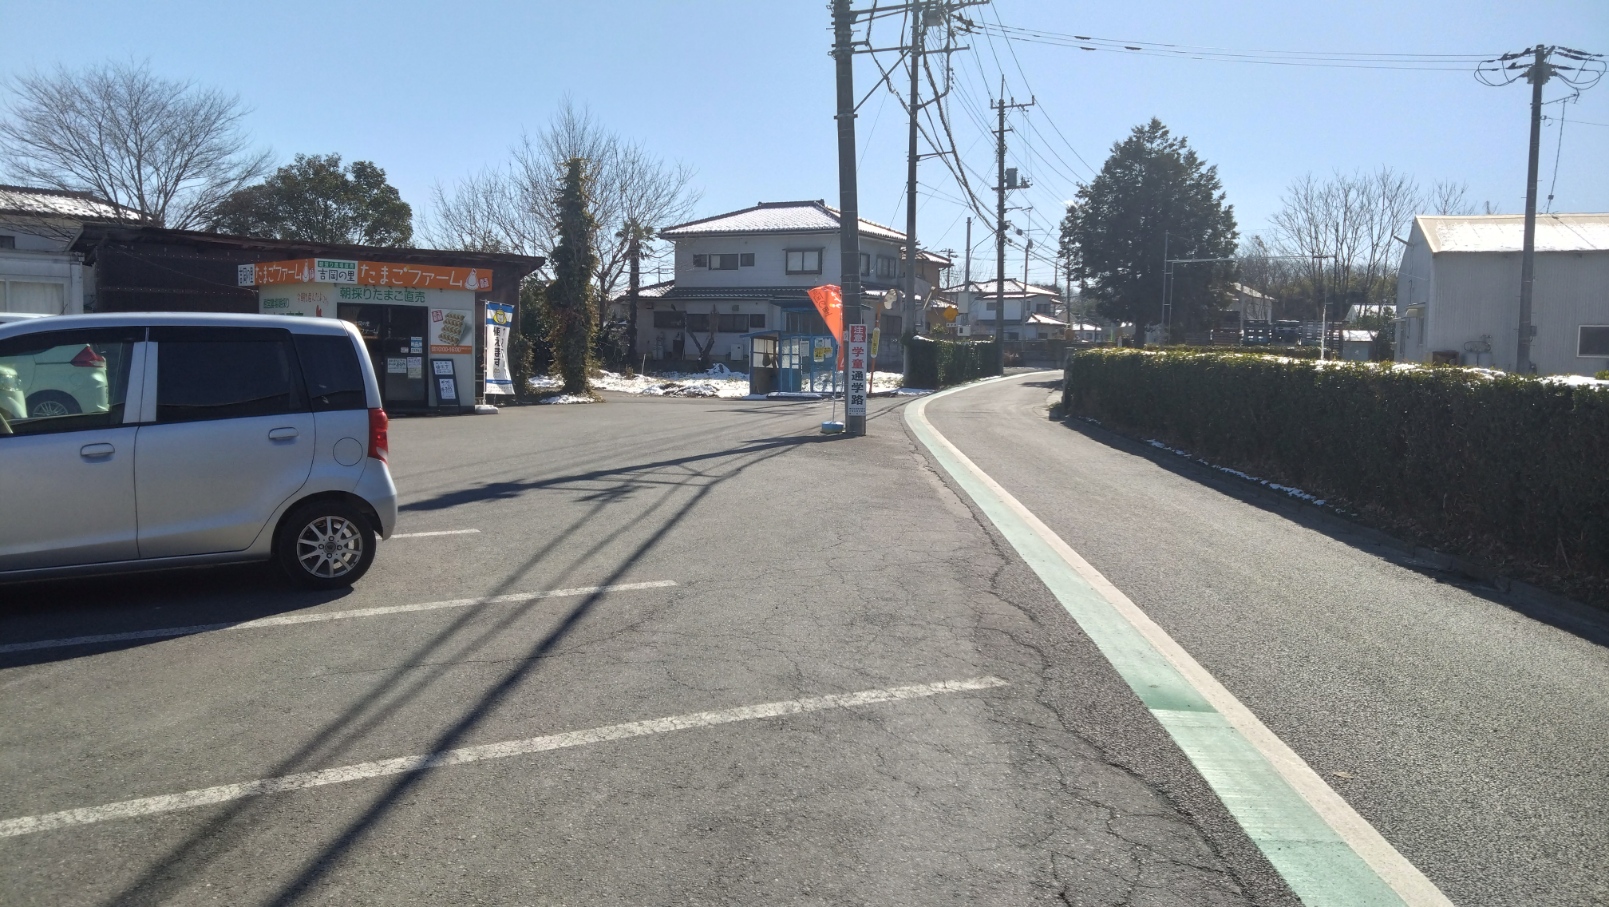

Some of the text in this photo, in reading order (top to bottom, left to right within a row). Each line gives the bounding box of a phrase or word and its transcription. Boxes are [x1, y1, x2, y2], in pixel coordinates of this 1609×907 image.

[255, 264, 302, 284] たまごファーム
[317, 268, 355, 281] 吉岡の里
[360, 264, 462, 287] たまごファーム
[340, 287, 425, 303] 朝採りたまご直売
[853, 326, 864, 342] 注意
[851, 346, 864, 405] 学童通学路
